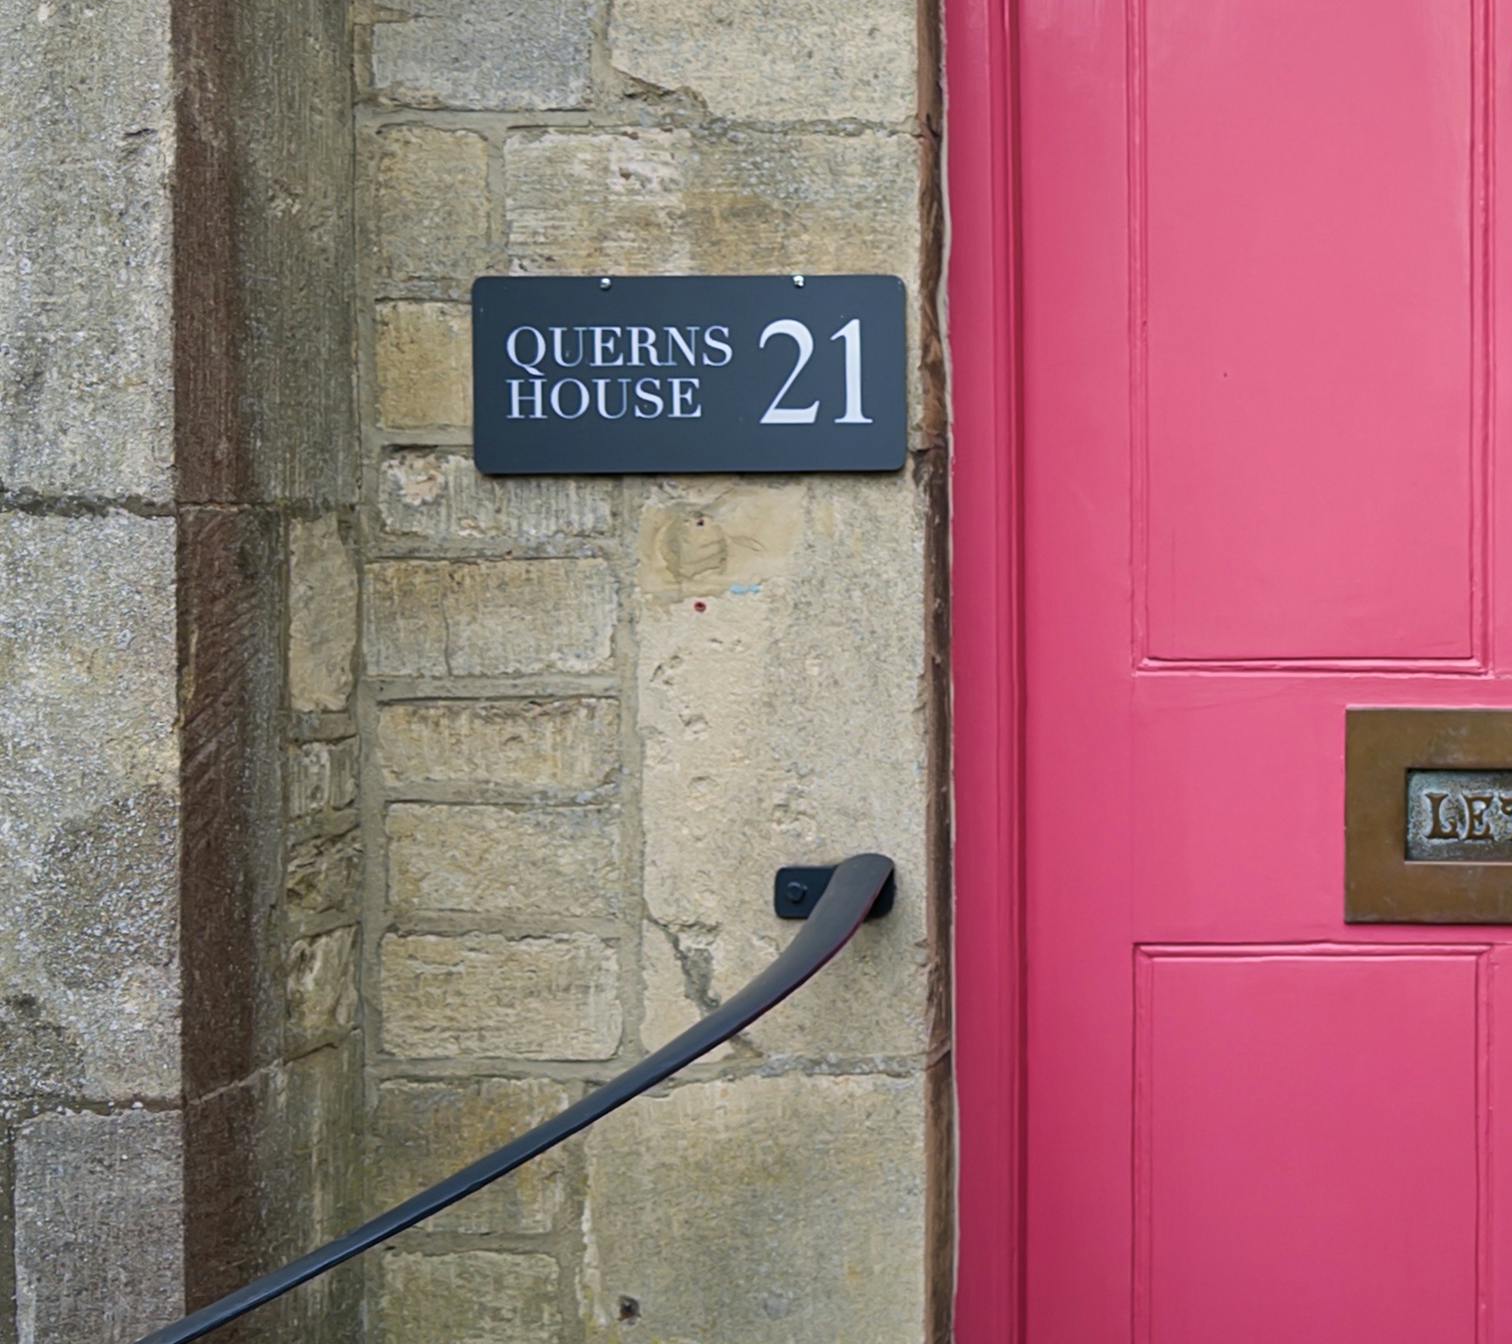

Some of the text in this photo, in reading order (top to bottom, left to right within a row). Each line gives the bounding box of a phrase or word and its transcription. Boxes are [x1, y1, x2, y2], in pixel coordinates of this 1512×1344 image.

[506, 326, 732, 376] QUERNS
[759, 319, 874, 424] 21
[506, 378, 702, 419] HOUSE
